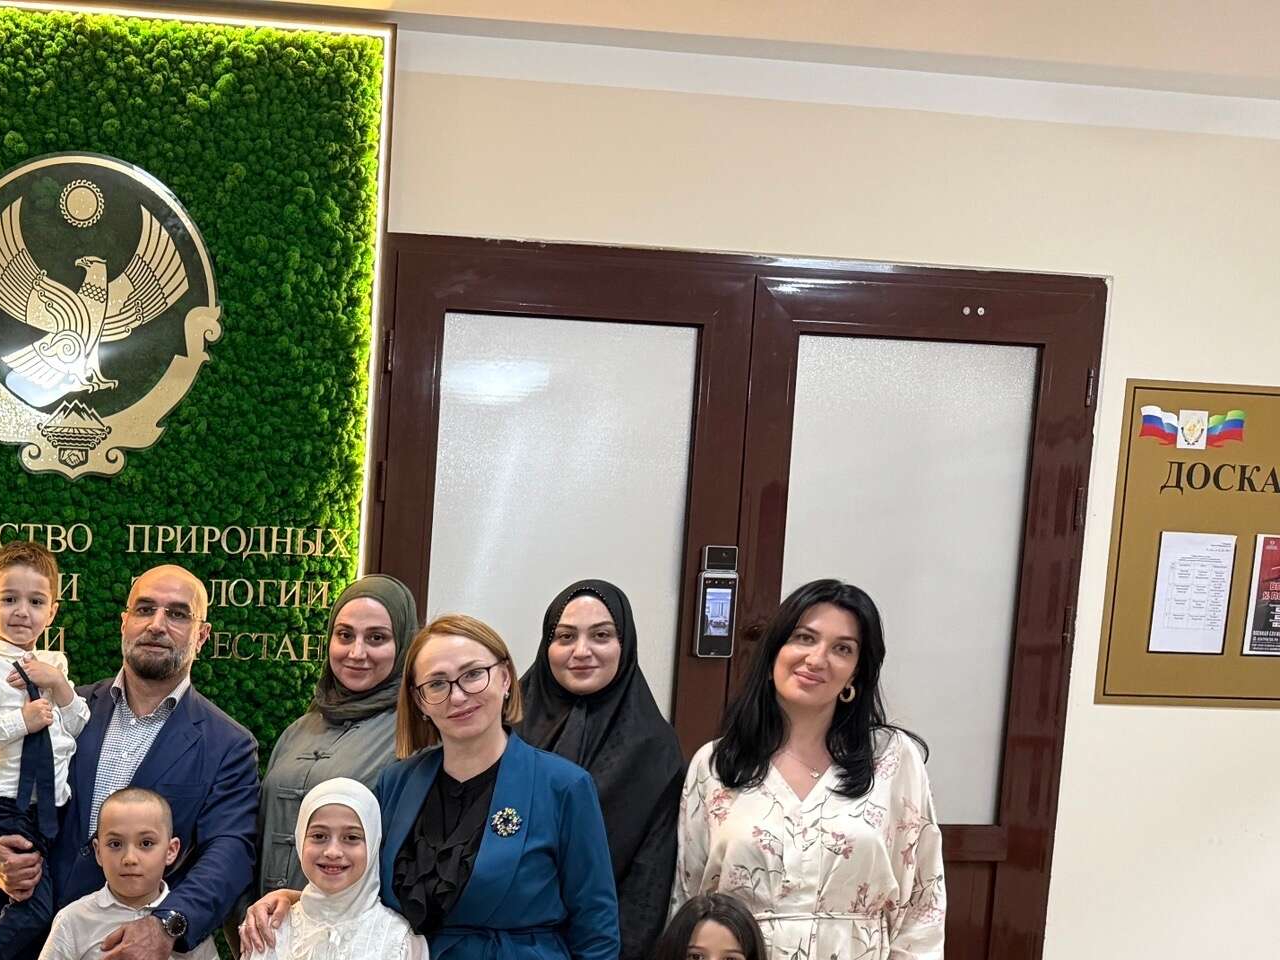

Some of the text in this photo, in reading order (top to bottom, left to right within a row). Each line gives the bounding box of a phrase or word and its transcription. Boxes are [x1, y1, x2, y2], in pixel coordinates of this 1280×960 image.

[1160, 461, 1280, 496] ДОСКА
[125, 524, 351, 561] ПРИРОДНЫХ
[195, 631, 326, 662] ЕСТАН
